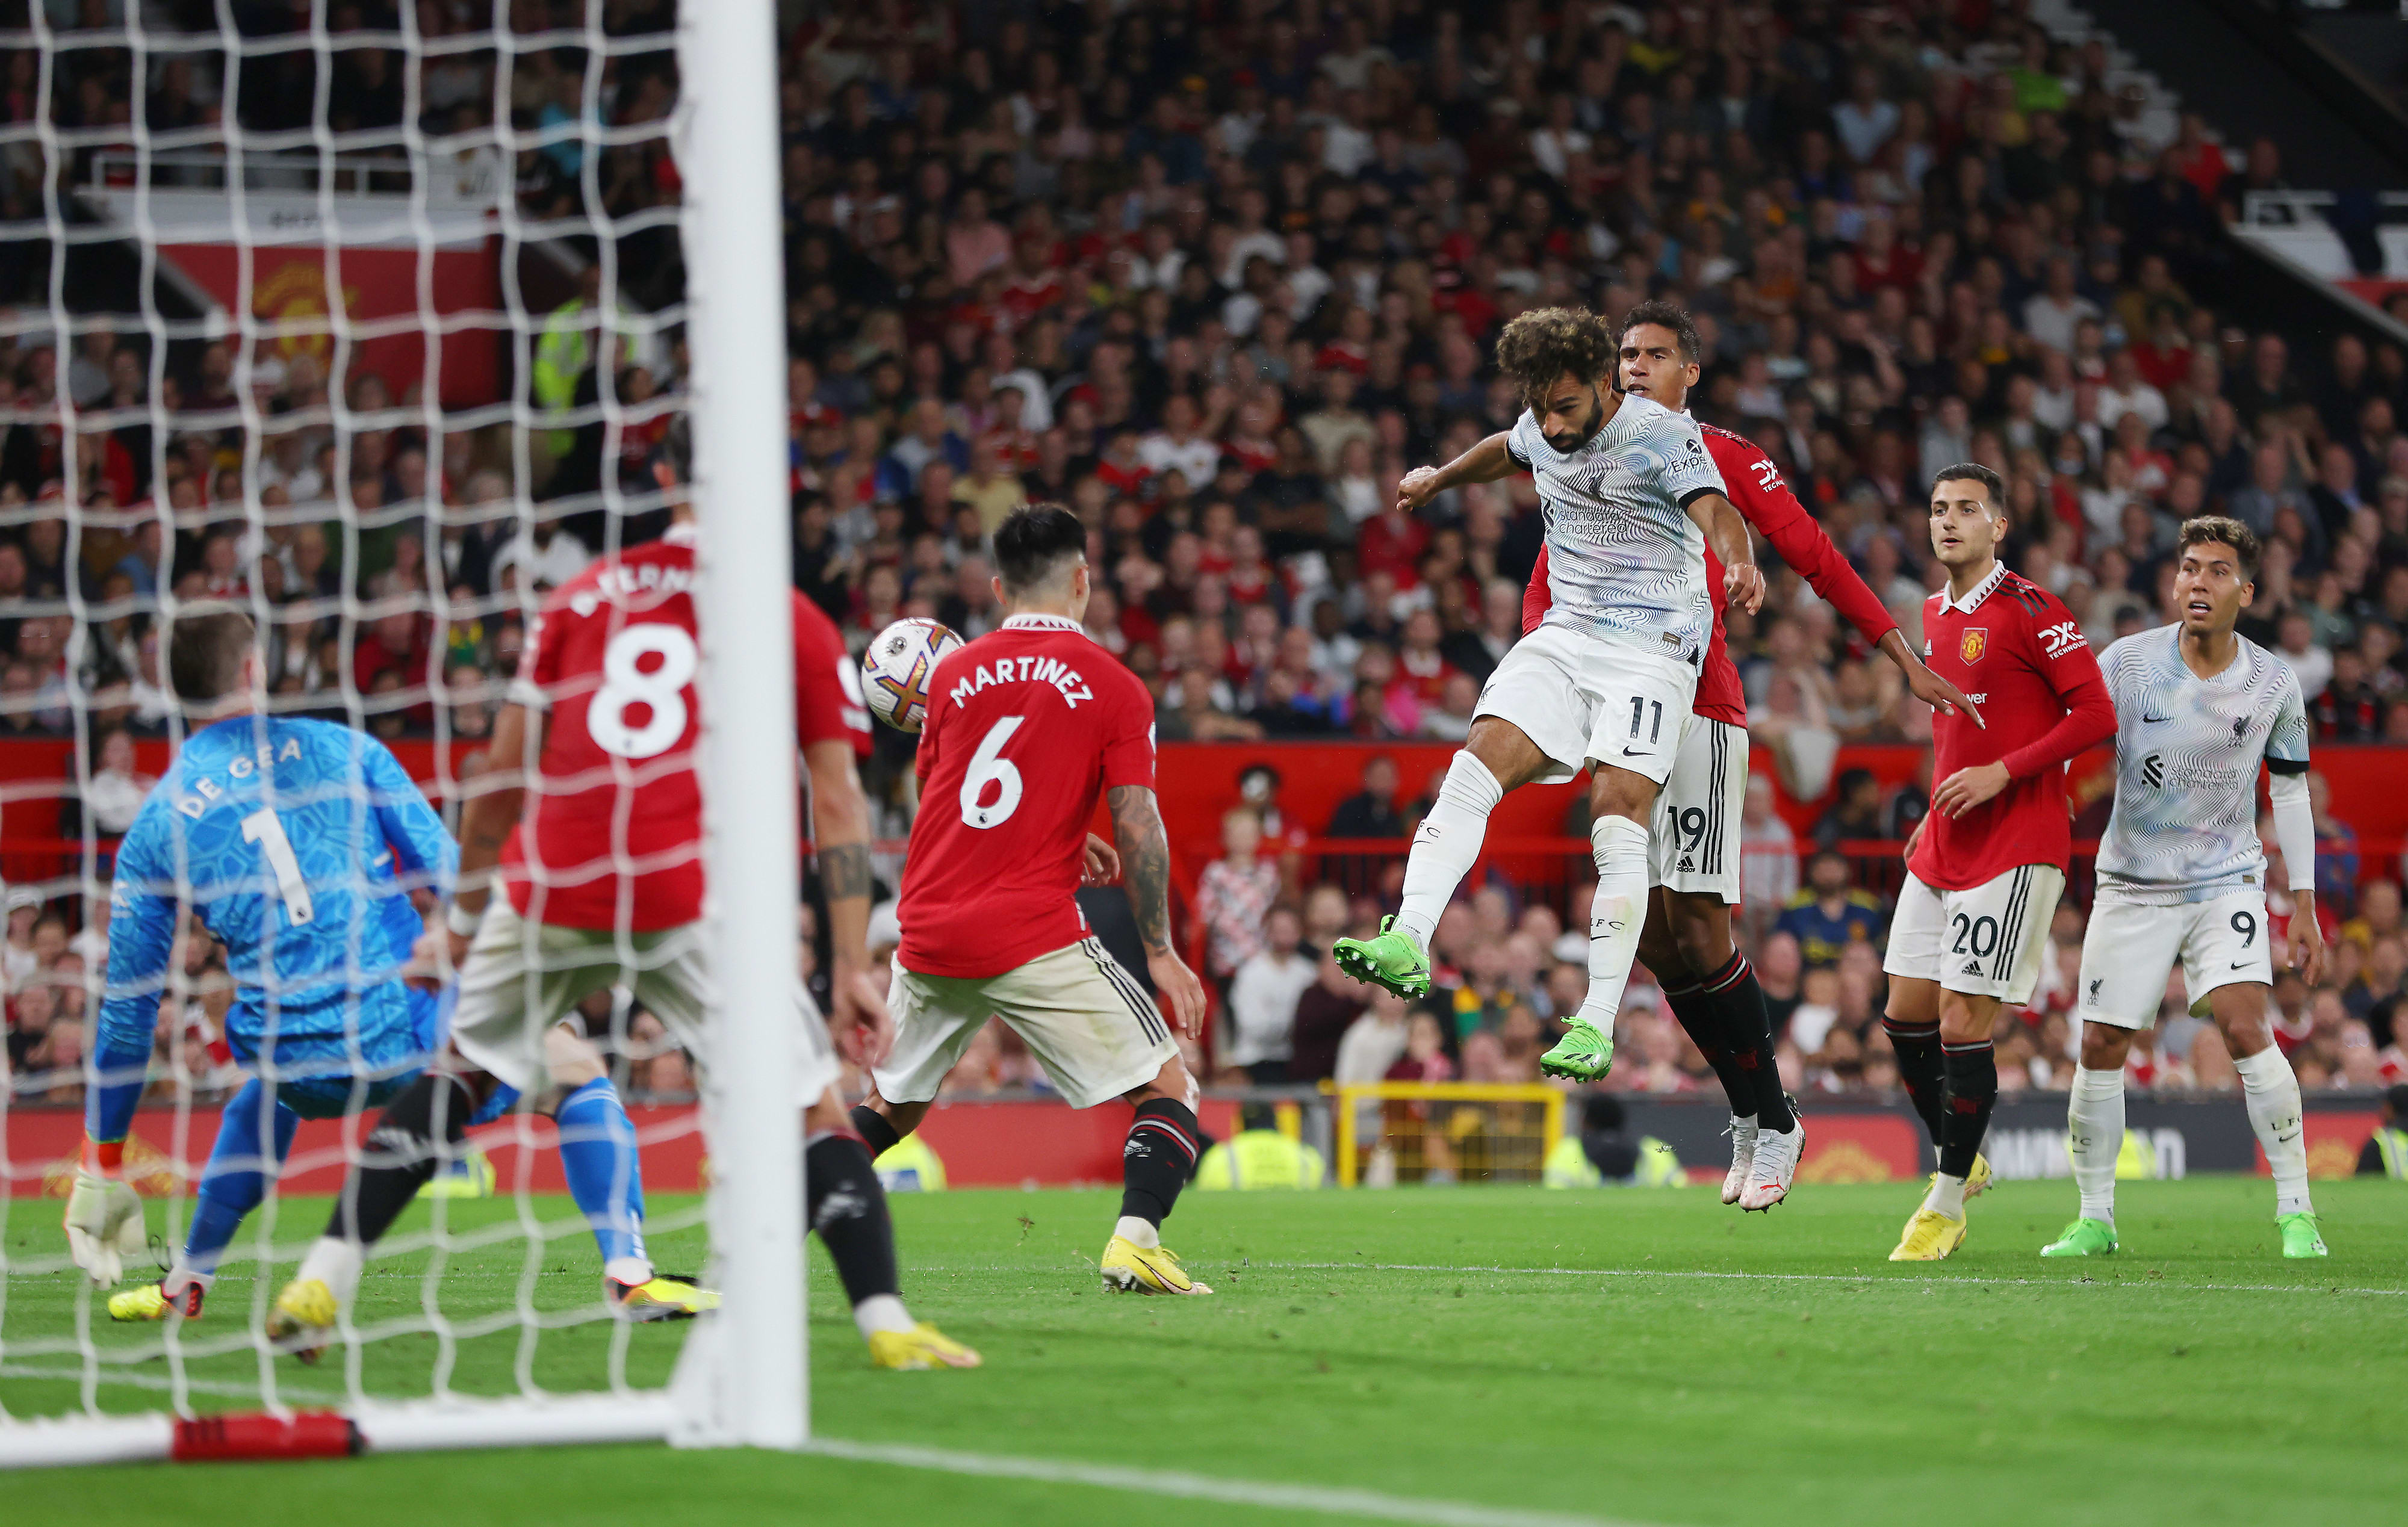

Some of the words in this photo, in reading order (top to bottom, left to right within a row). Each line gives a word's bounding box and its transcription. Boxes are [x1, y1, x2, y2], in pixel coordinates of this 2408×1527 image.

[1751, 459, 1778, 486] DX
[1559, 521, 1627, 534] chartered
[1560, 510, 1619, 521] standard
[2037, 621, 2085, 653] DXC
[586, 623, 698, 759] 8
[950, 655, 1093, 709] MARTINEZ
[1630, 696, 1662, 745] 11
[177, 777, 222, 819] DE
[229, 738, 302, 778] GEA
[960, 715, 1025, 829] 6
[1418, 822, 1441, 838] FC
[1668, 806, 1706, 852] 19
[241, 807, 315, 927] 1
[1952, 912, 1998, 958] 20
[2230, 911, 2256, 949] 9
[1962, 968, 1984, 977] adidas
